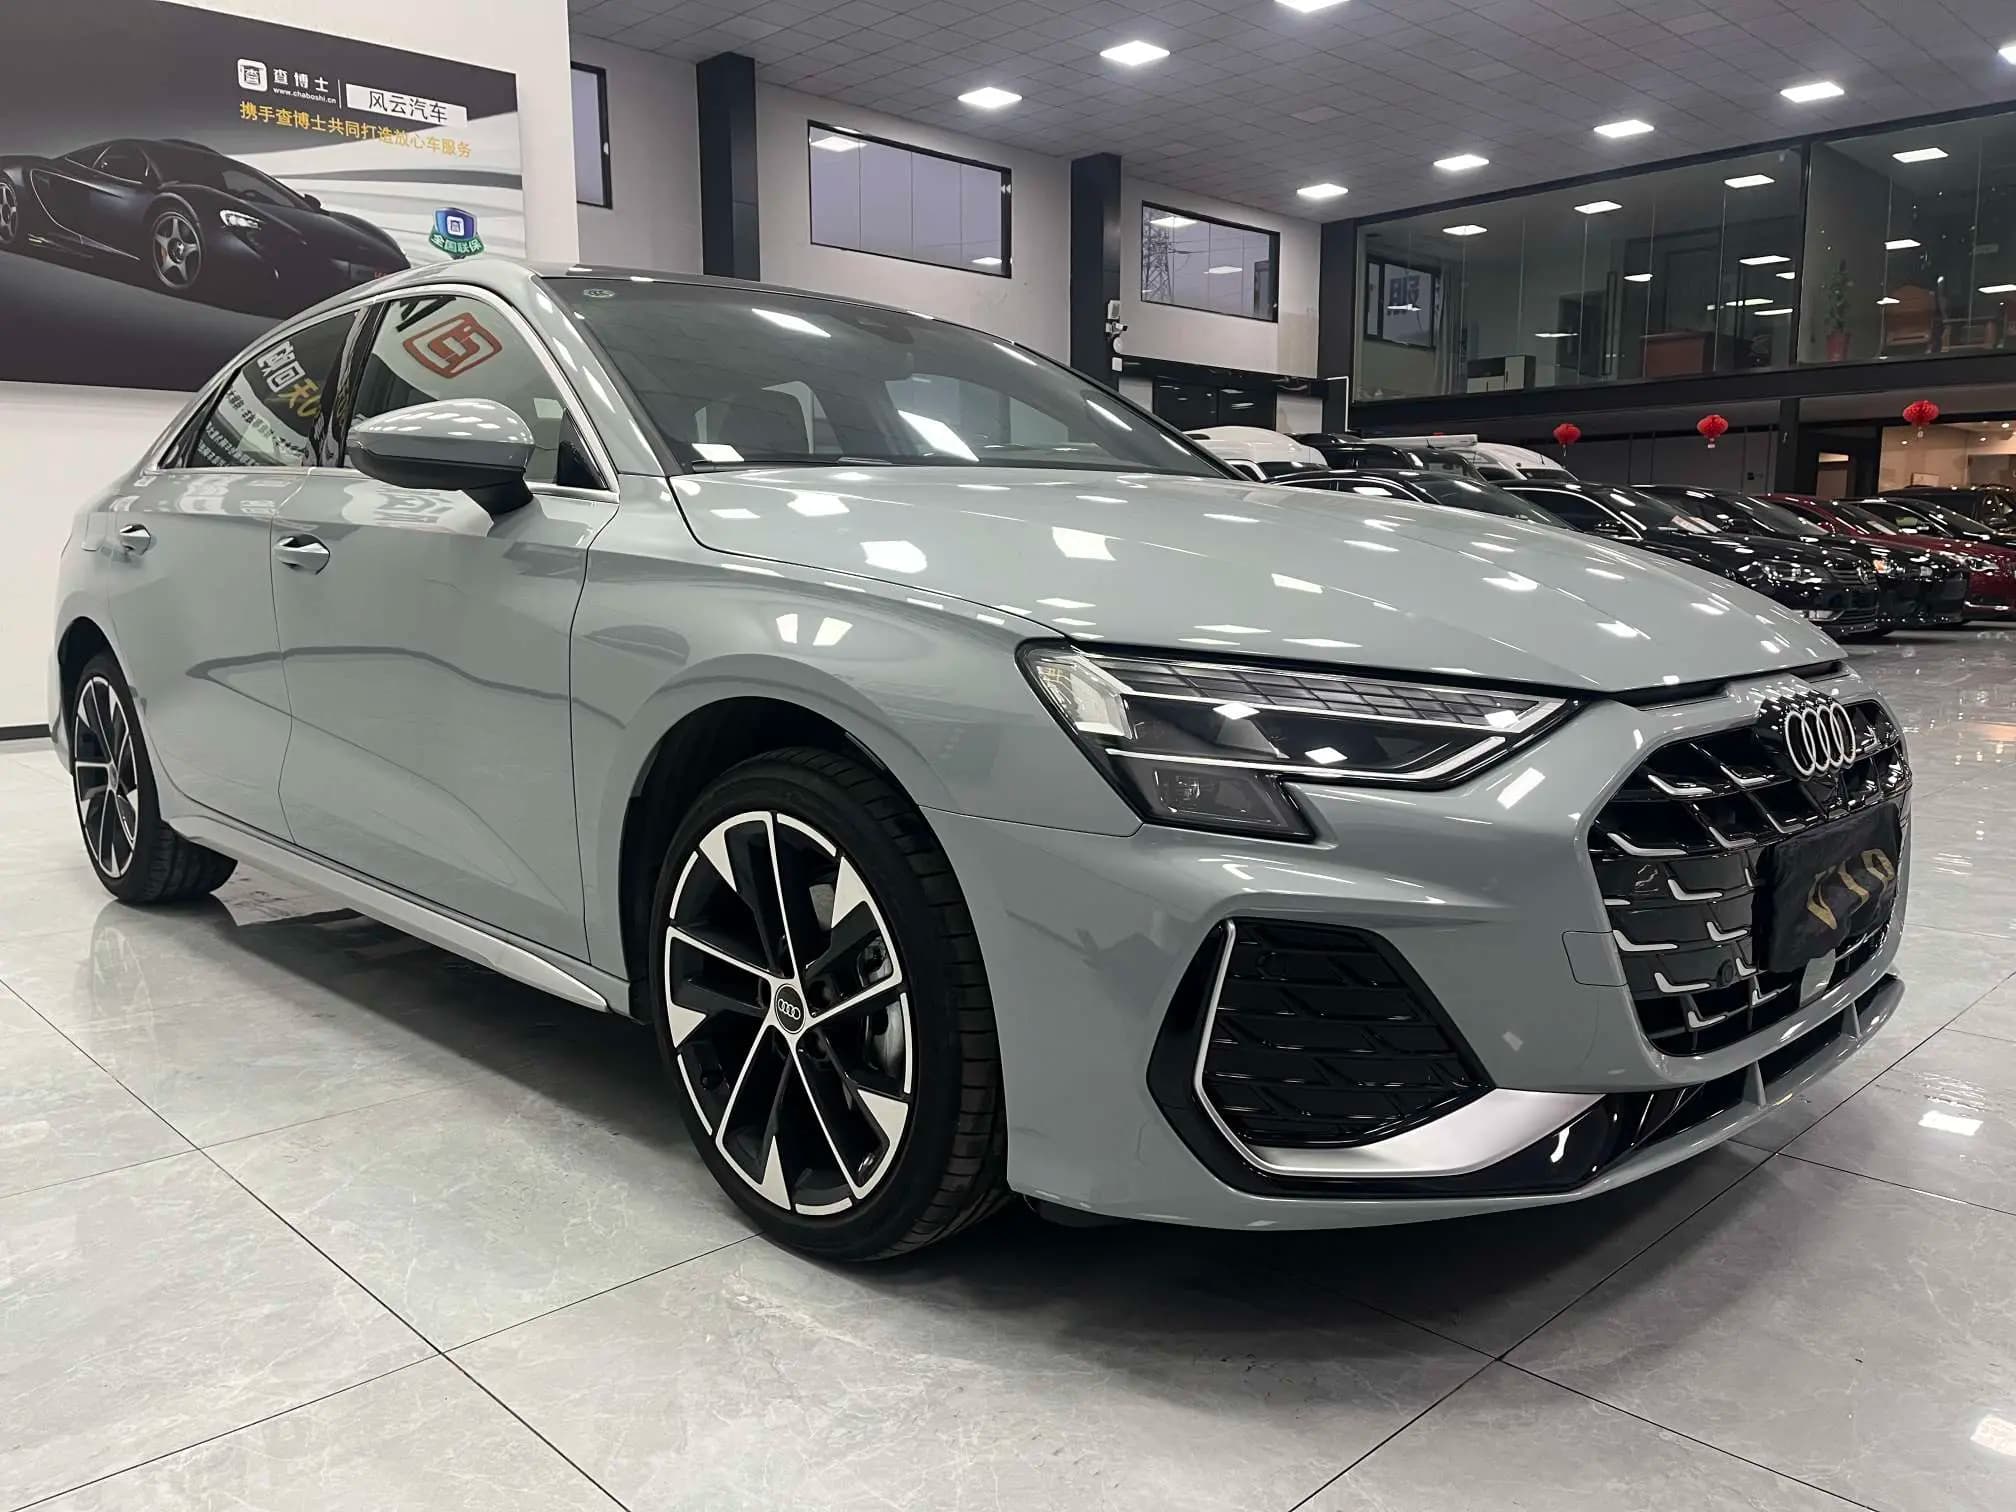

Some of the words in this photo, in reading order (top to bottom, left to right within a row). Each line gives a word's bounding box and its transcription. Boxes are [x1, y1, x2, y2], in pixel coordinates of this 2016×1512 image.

[273, 68, 330, 92] 查博士
[272, 87, 337, 104] www.chaboshi.cn
[369, 90, 448, 123] 风云汽车
[240, 101, 472, 158] 携手查博士共同打造放心车服务
